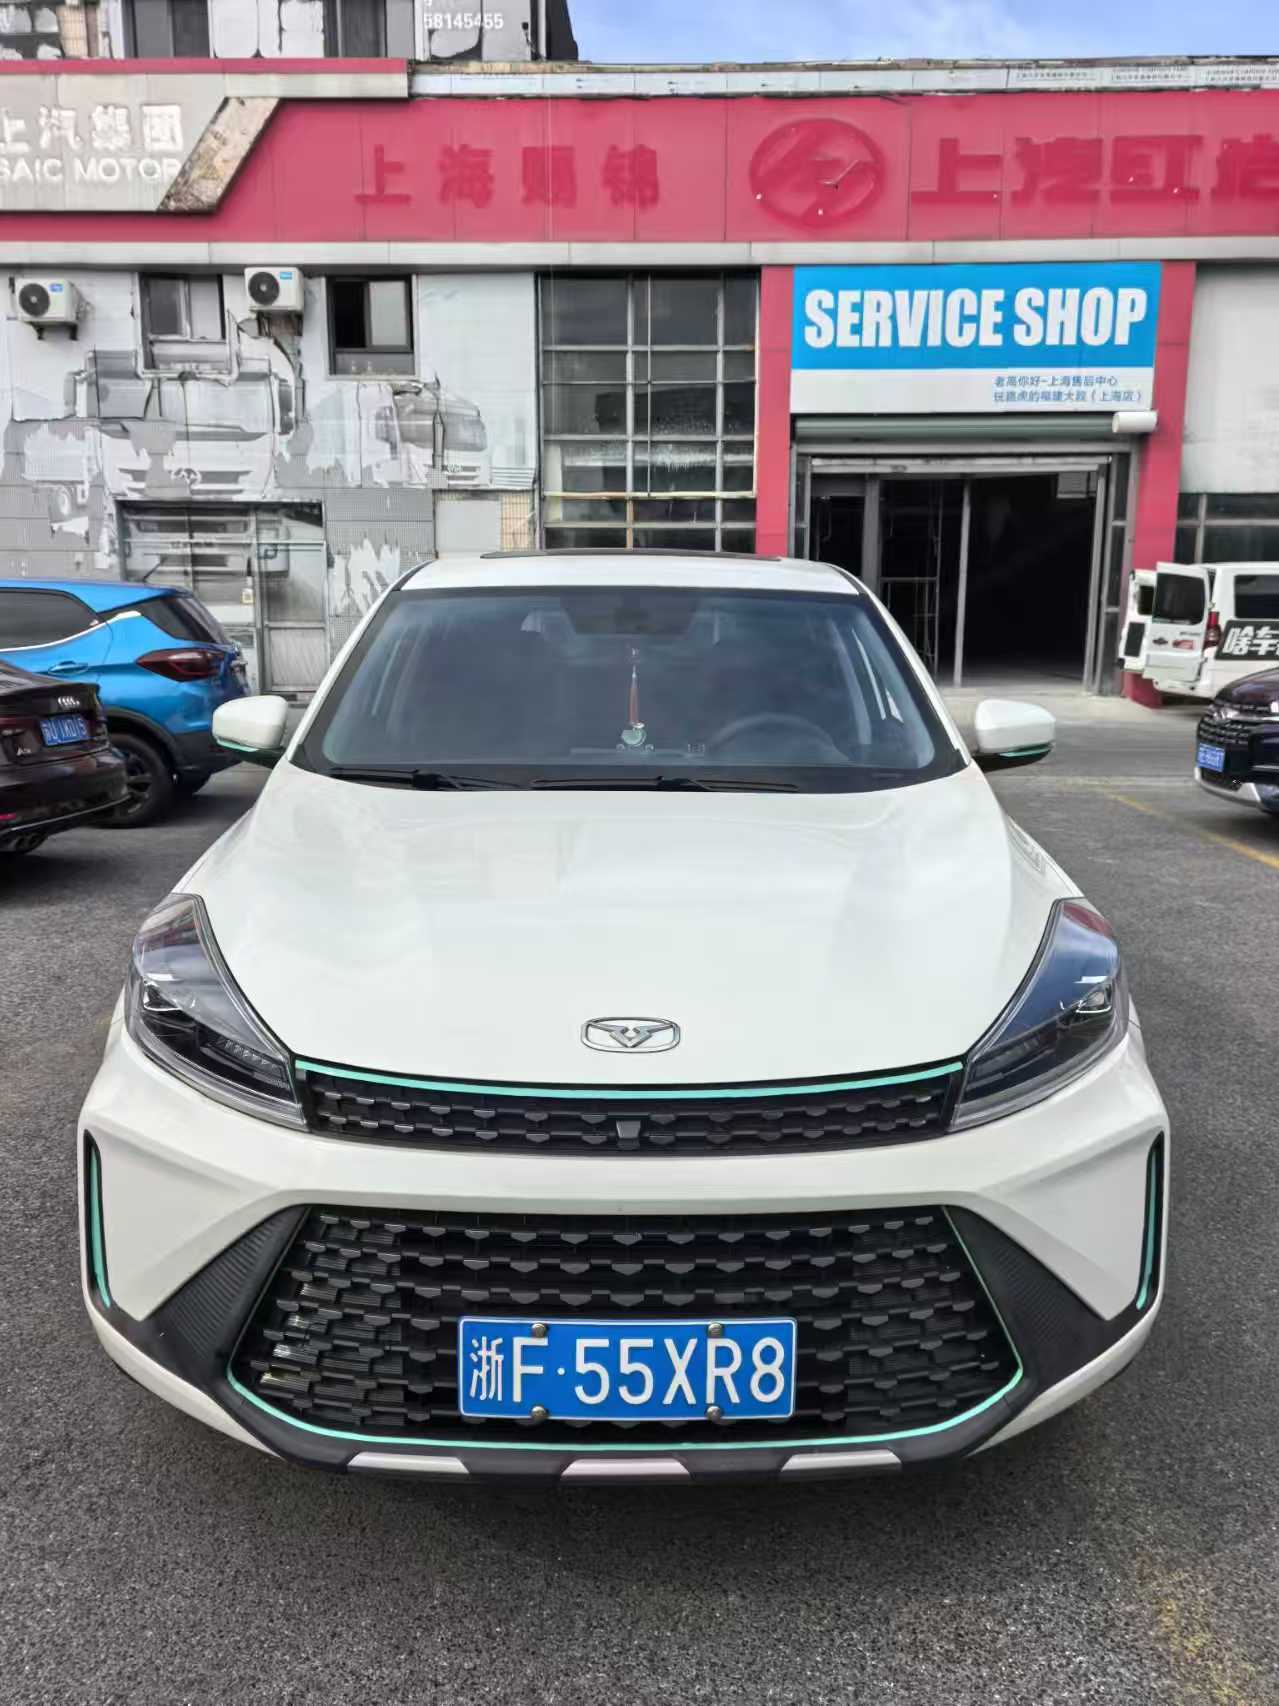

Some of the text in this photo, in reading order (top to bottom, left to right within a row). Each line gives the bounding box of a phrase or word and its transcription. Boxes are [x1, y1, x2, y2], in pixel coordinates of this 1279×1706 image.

[0, 157, 63, 184] SAIC
[804, 287, 1146, 348] SERVICE SHOP
[1222, 625, 1279, 656] 啥车
[470, 1336, 785, 1404] 浙F·55XR8
